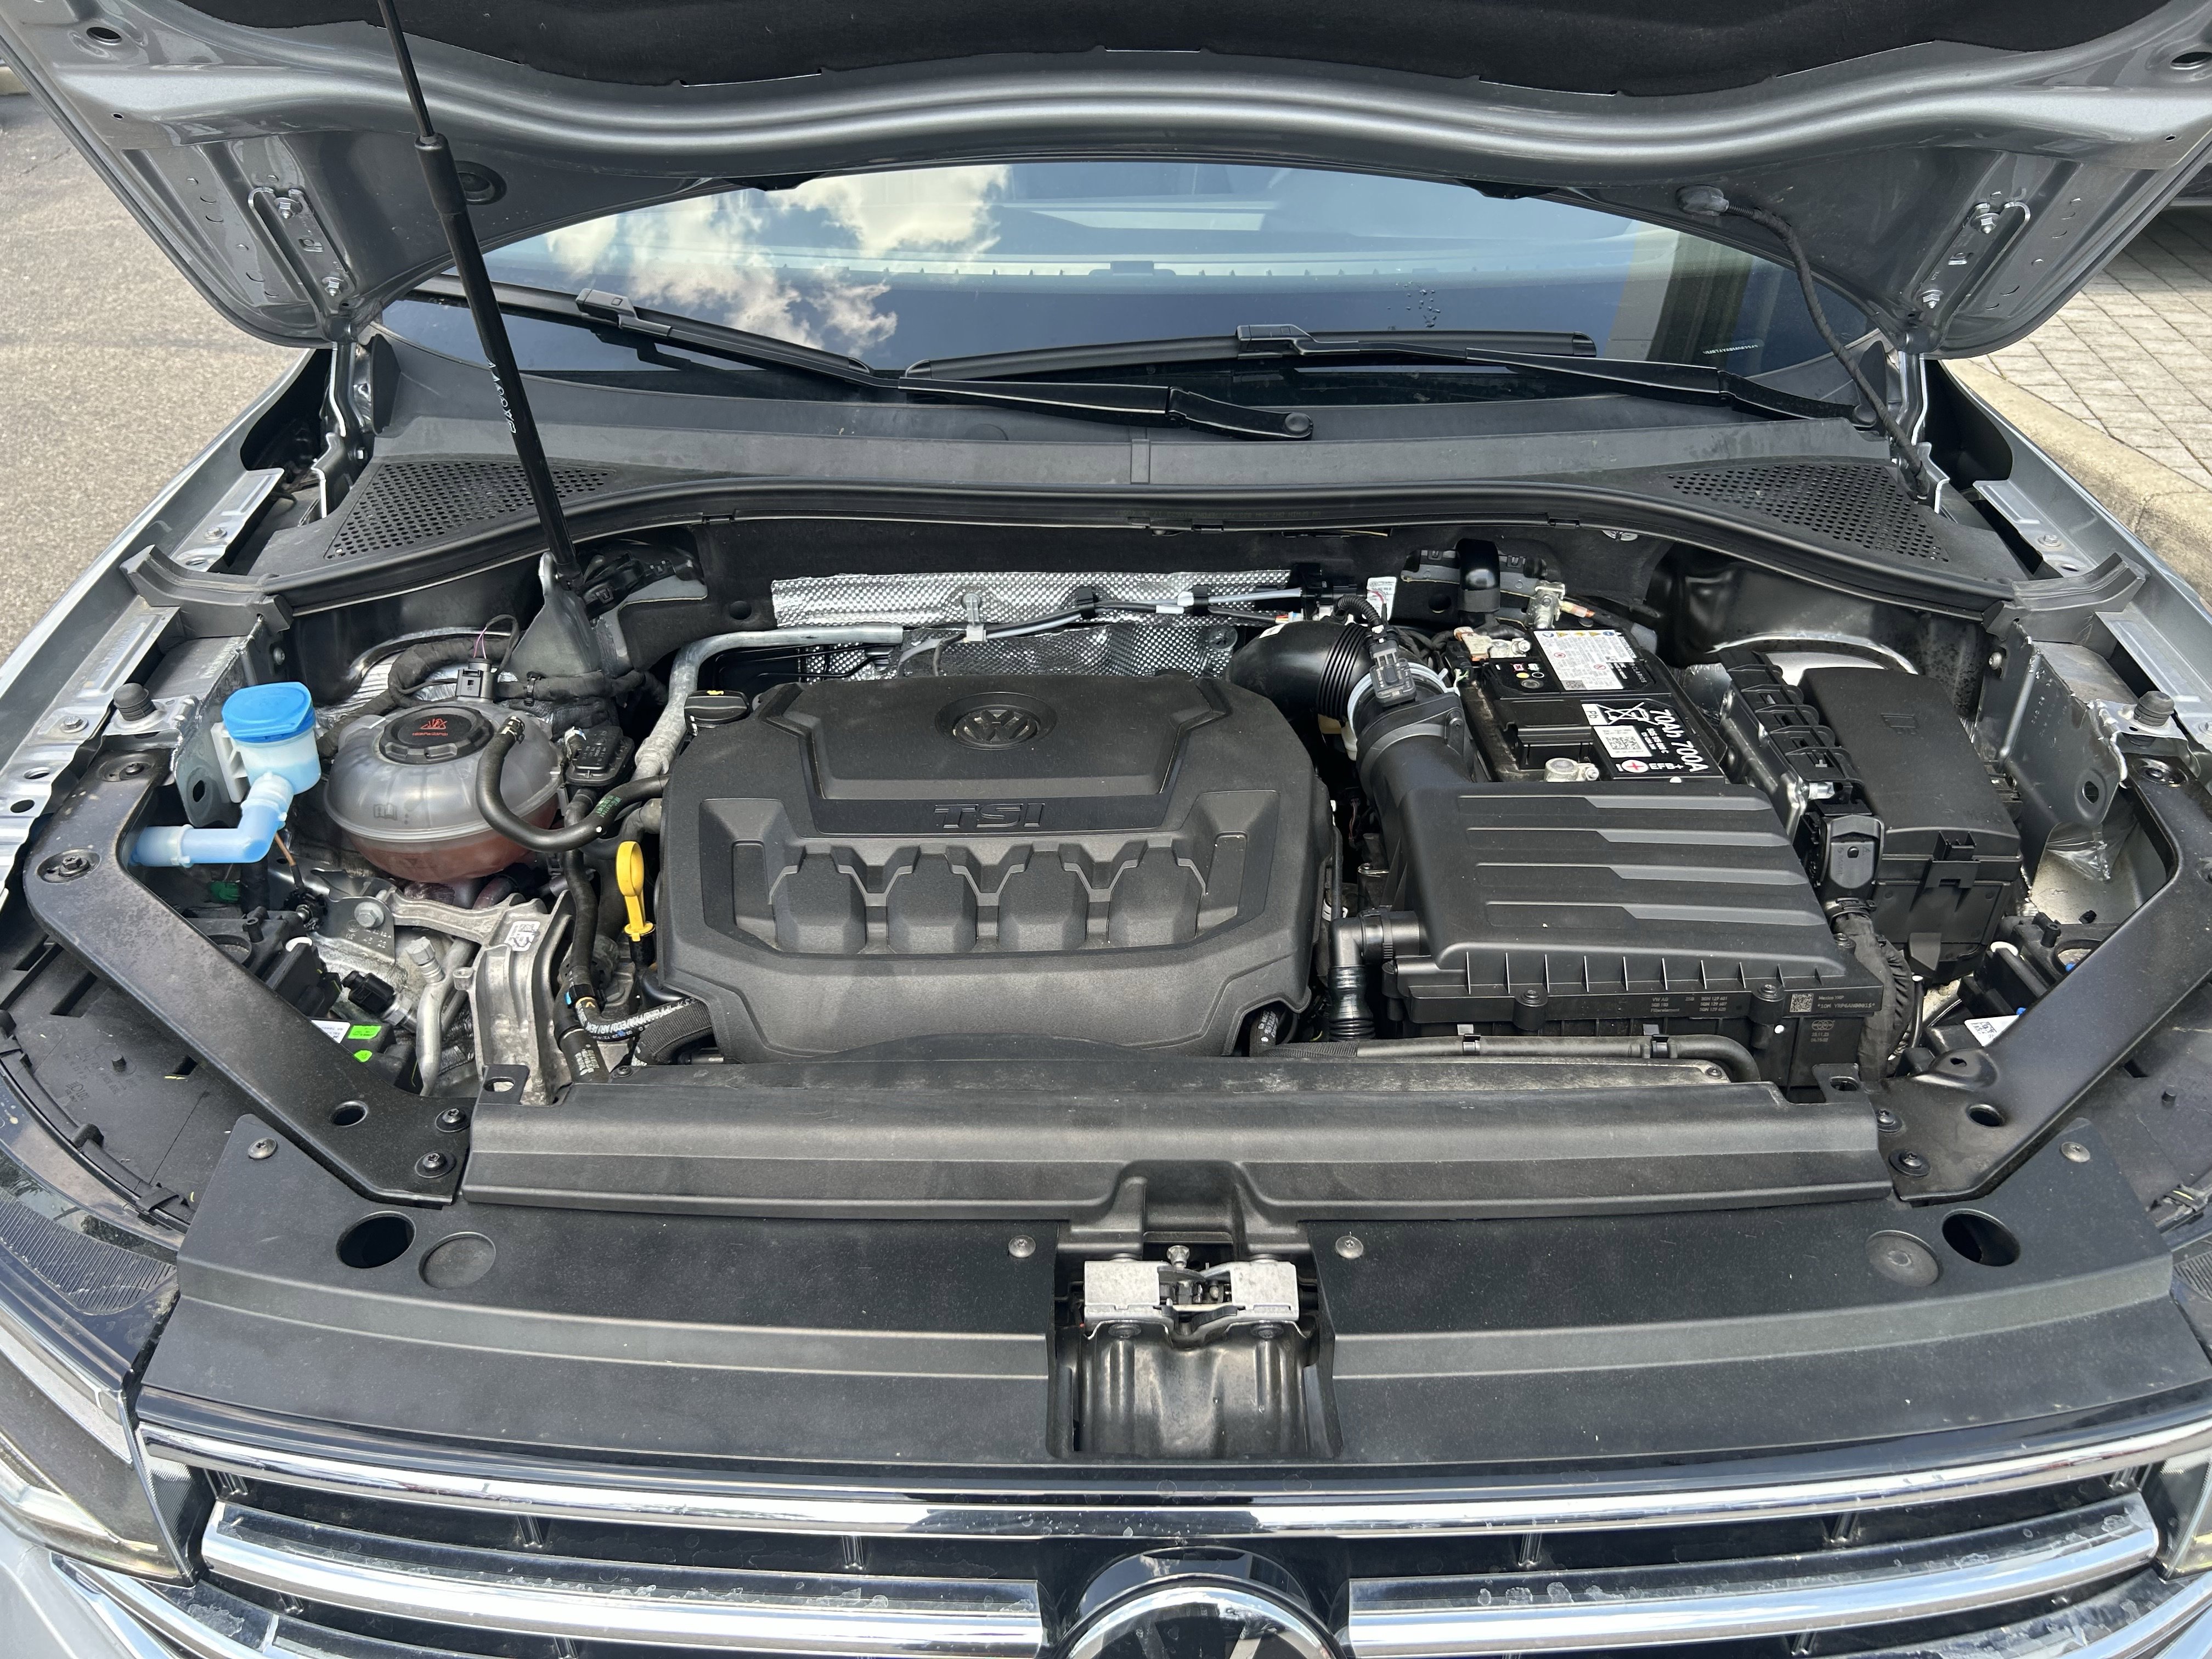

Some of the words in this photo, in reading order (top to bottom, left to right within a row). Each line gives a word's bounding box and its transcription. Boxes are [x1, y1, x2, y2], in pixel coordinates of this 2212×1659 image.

[1585, 710, 1599, 719] Pb
[1649, 708, 1685, 738] 70Ah
[1671, 740, 1709, 773] 700A
[1648, 762, 1684, 770] EFB+
[934, 802, 1046, 829] TSI
